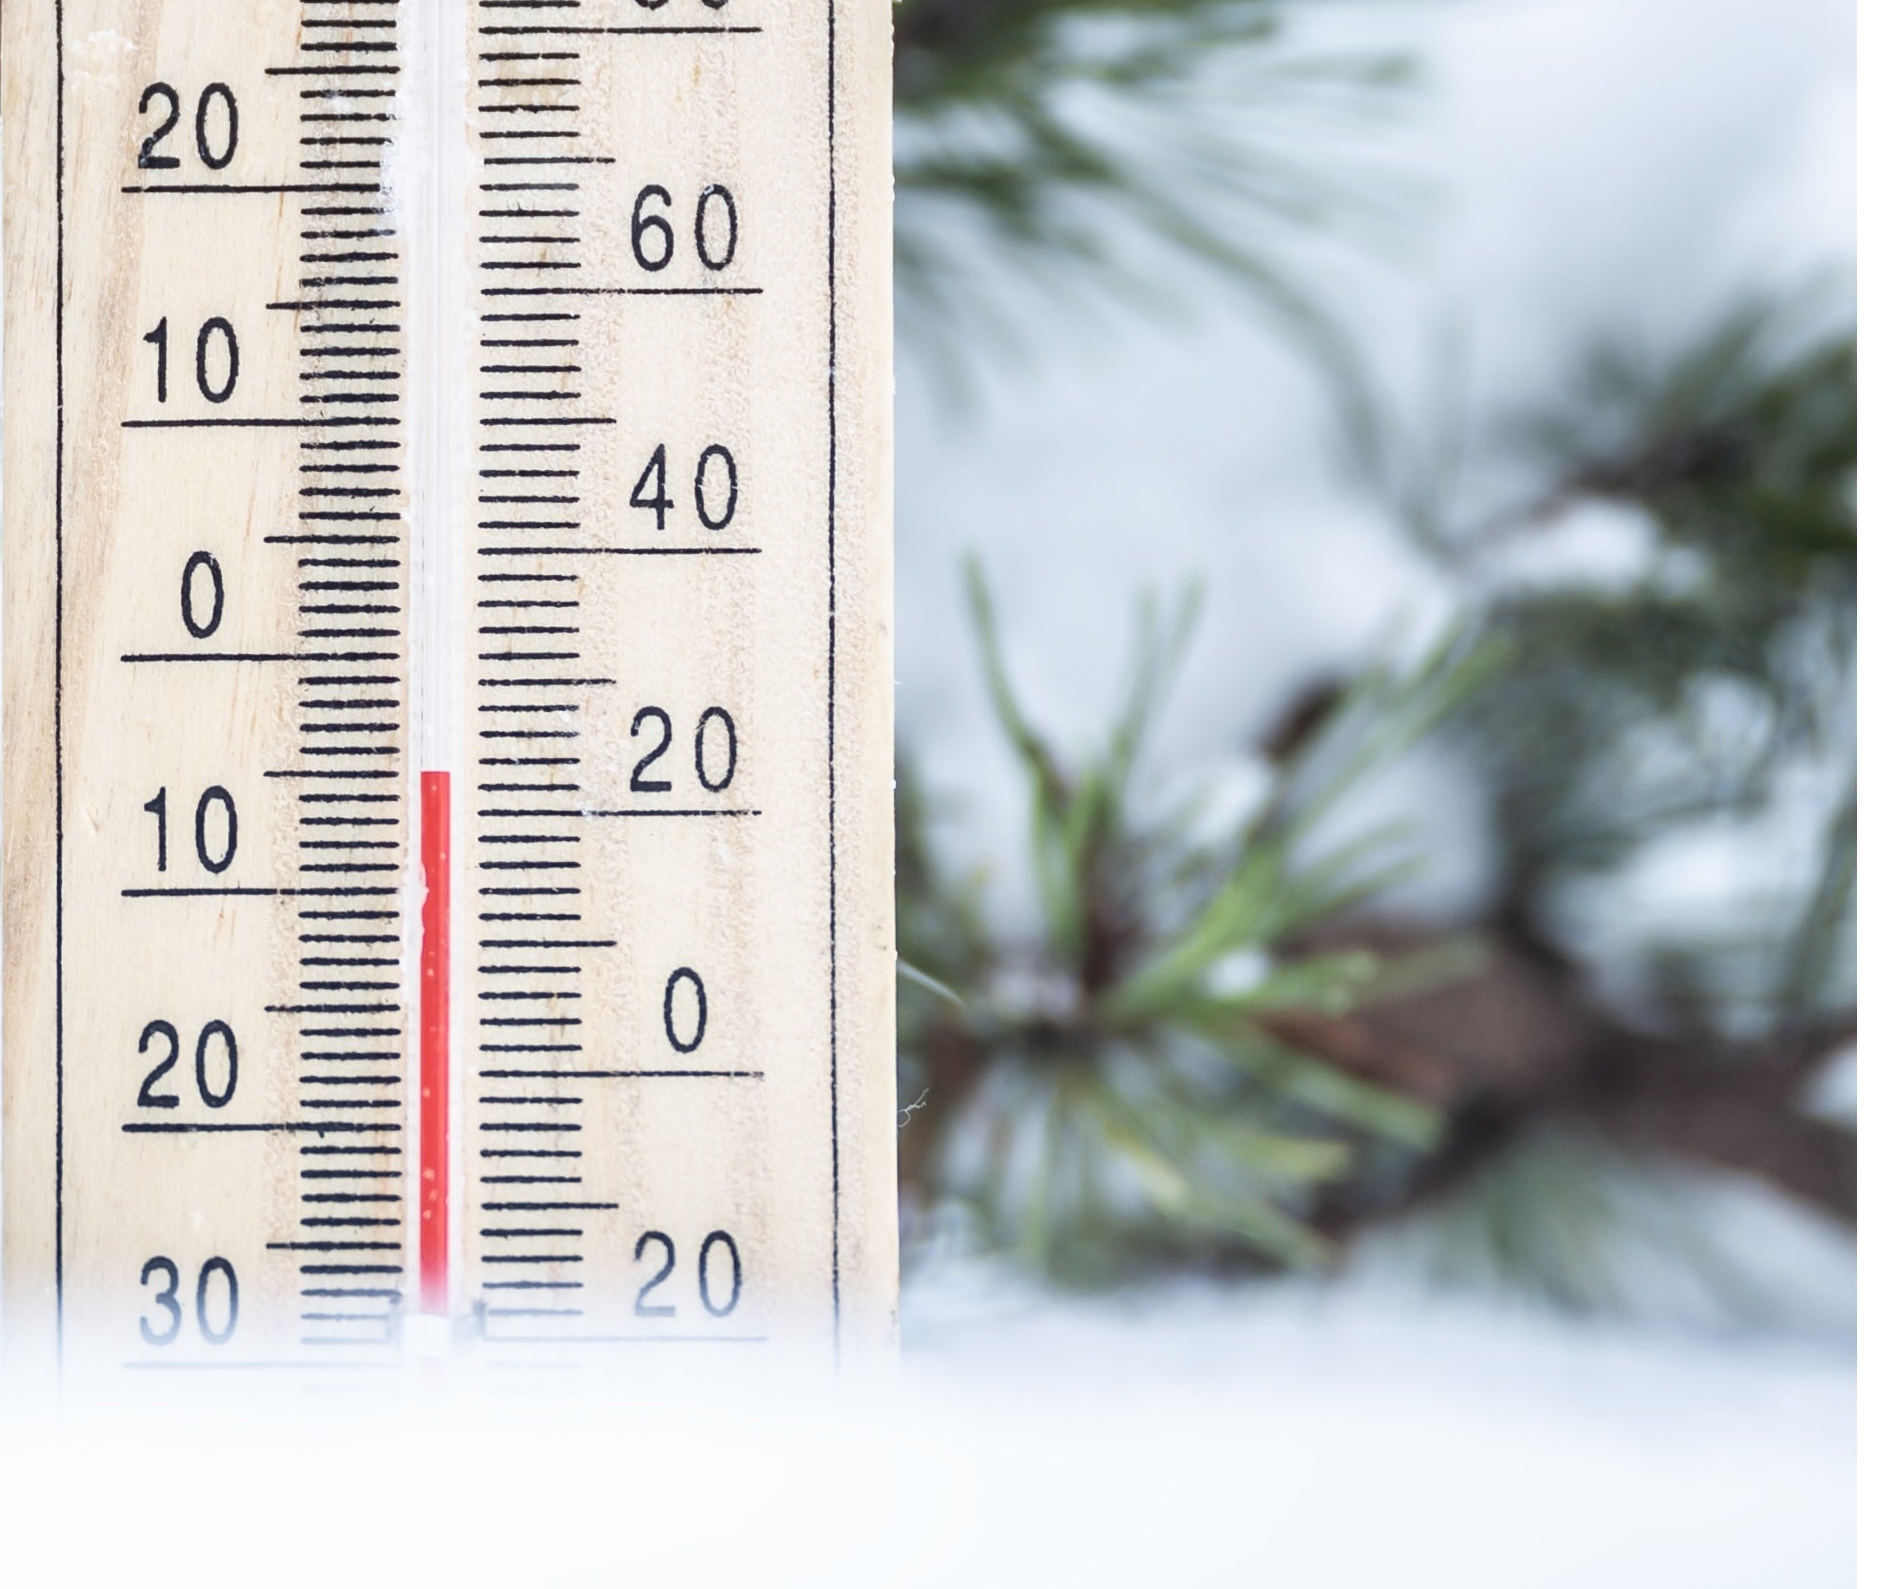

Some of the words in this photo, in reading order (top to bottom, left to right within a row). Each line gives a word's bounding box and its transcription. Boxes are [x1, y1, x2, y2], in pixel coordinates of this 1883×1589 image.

[137, 81, 239, 171] 20
[631, 183, 738, 273] 60
[142, 316, 240, 404] 10
[629, 443, 739, 531] 40
[180, 550, 225, 640] 0
[629, 705, 738, 793] 20
[143, 785, 238, 875] 10
[663, 966, 708, 1054] 0
[137, 1019, 238, 1109] 20
[139, 1255, 239, 1346] 30
[633, 1229, 743, 1318] 20
